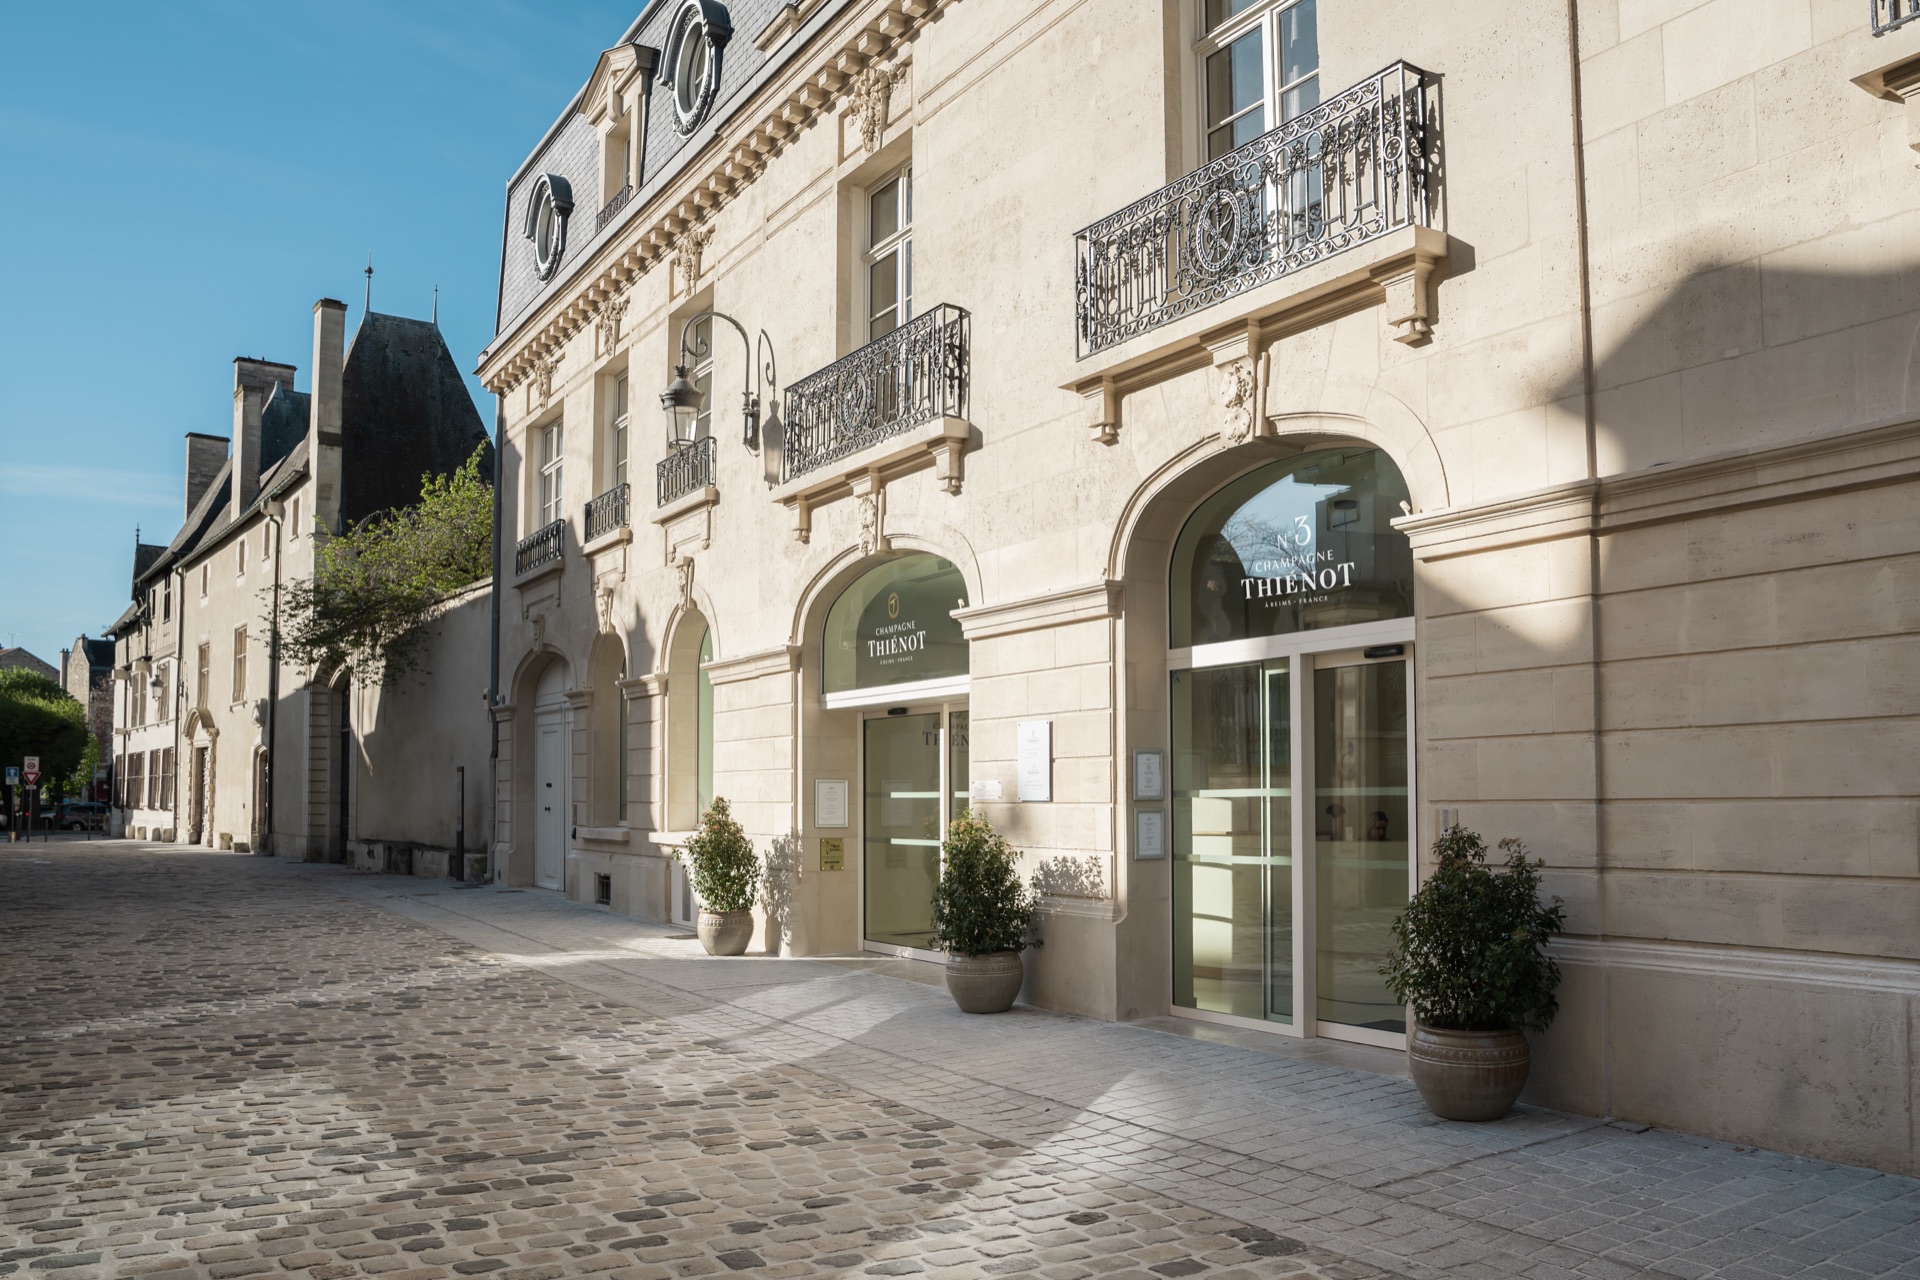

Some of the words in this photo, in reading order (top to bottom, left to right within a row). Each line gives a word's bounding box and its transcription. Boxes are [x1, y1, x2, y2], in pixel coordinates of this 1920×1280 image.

[1294, 515, 1312, 547] 3
[1255, 549, 1335, 573] CHAMPAGNE
[1240, 562, 1356, 600] THIÉNOT
[1299, 595, 1329, 605] FRANCE
[875, 620, 916, 636] CHAMPAGNE
[868, 630, 926, 657] THIÉNOT
